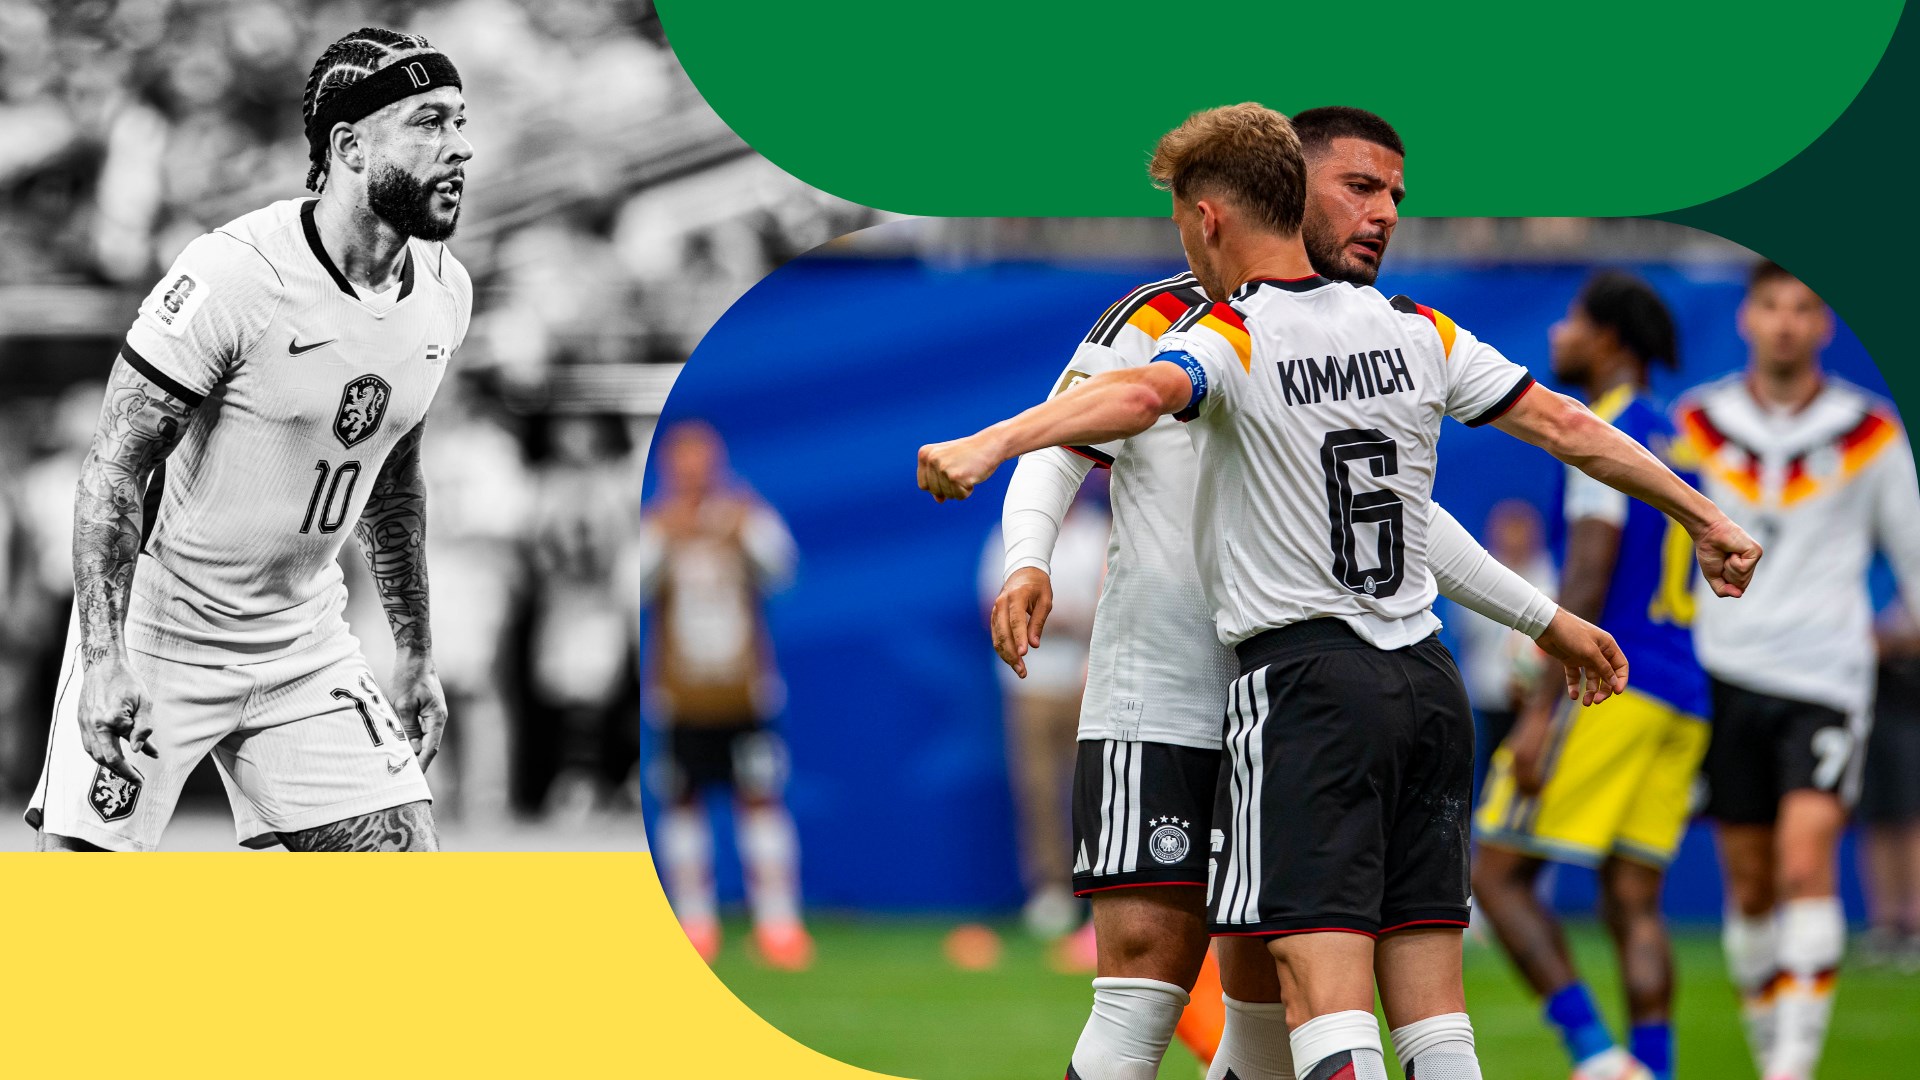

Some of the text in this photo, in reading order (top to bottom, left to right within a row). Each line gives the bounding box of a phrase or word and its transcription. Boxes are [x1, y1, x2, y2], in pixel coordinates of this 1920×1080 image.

[400, 61, 430, 88] 10
[1276, 348, 1415, 407] KIMMICH
[299, 459, 362, 535] 10
[1320, 428, 1405, 599] 6
